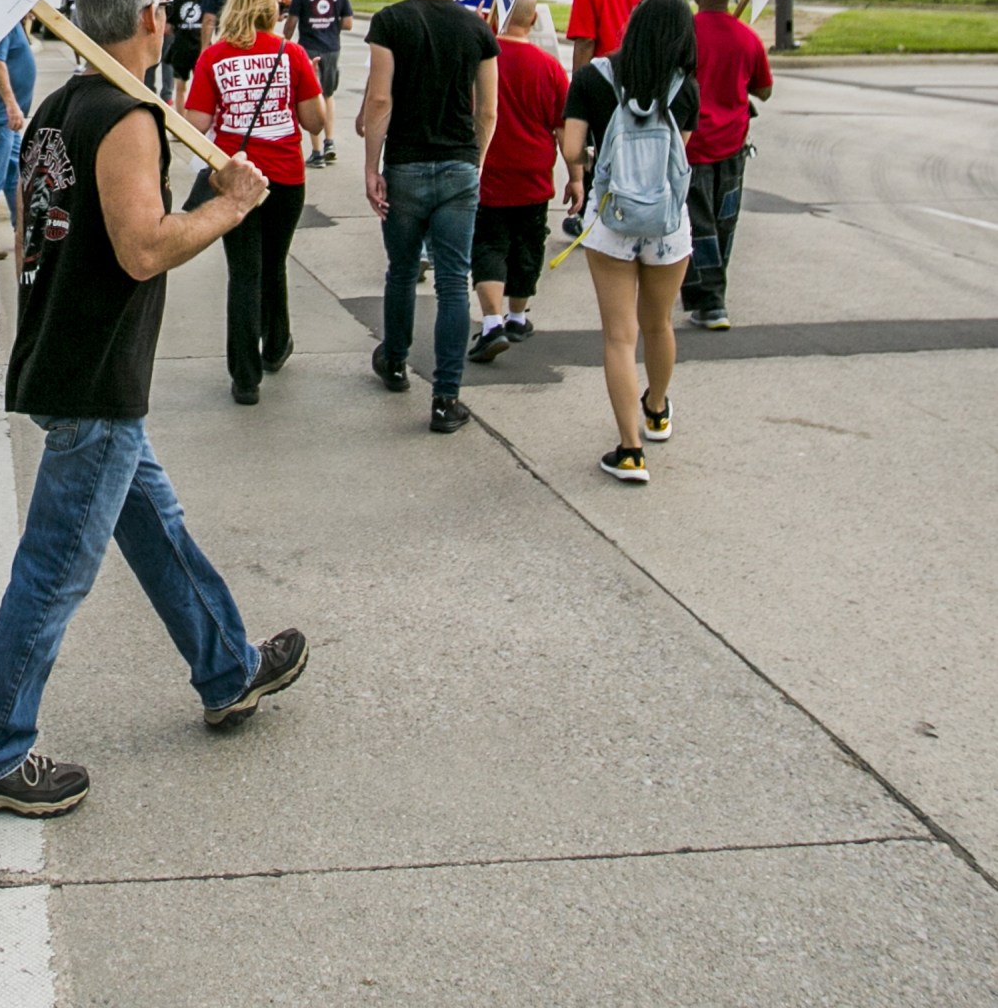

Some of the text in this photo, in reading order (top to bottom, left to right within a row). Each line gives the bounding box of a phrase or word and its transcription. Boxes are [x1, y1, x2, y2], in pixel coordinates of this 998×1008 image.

[217, 59, 240, 77] ONE
[221, 75, 242, 90] ONE
[234, 113, 261, 128] MORE
